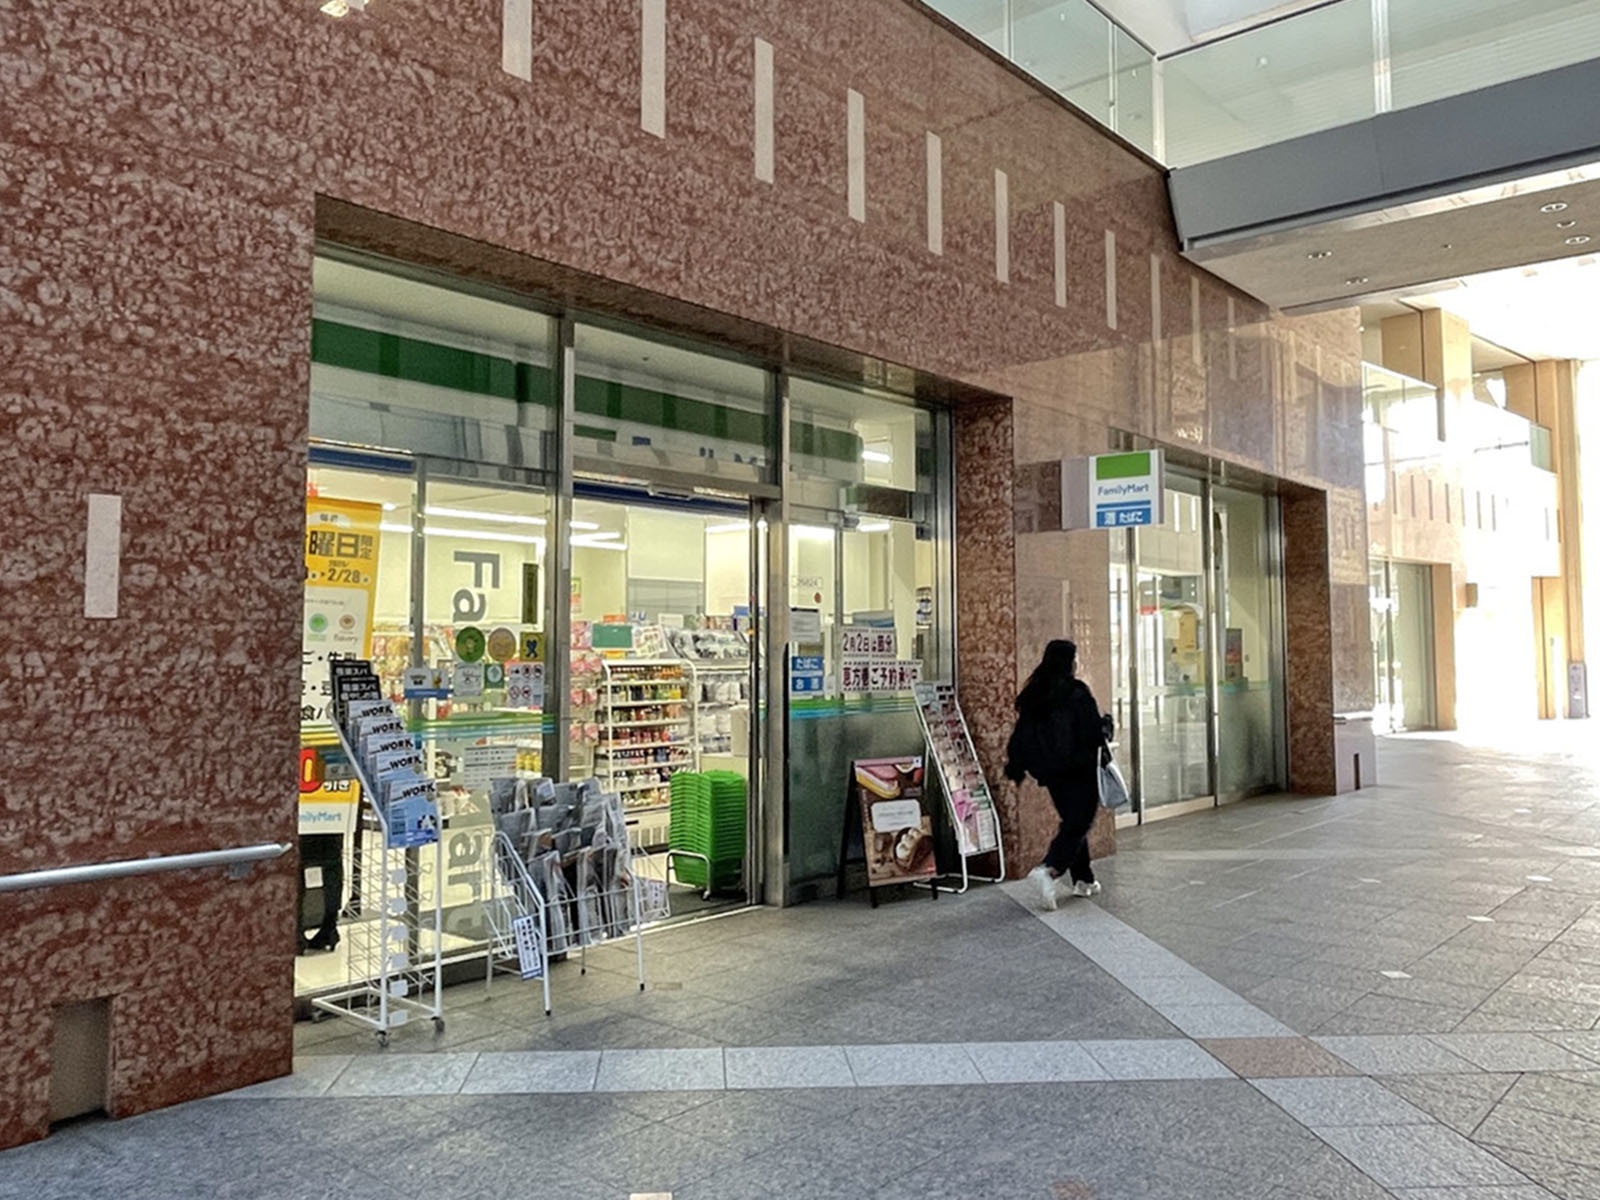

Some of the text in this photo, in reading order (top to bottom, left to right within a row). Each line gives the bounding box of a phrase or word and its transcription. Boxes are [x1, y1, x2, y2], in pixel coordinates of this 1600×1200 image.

[1097, 484, 1149, 495] FamilyMart
[1119, 511, 1143, 524] たばこ
[328, 568, 361, 583] 2/28
[362, 704, 393, 717] WORK
[371, 721, 404, 734] WORK
[380, 738, 414, 752] WORK
[389, 755, 423, 768] WORK
[401, 782, 436, 797] WORK
